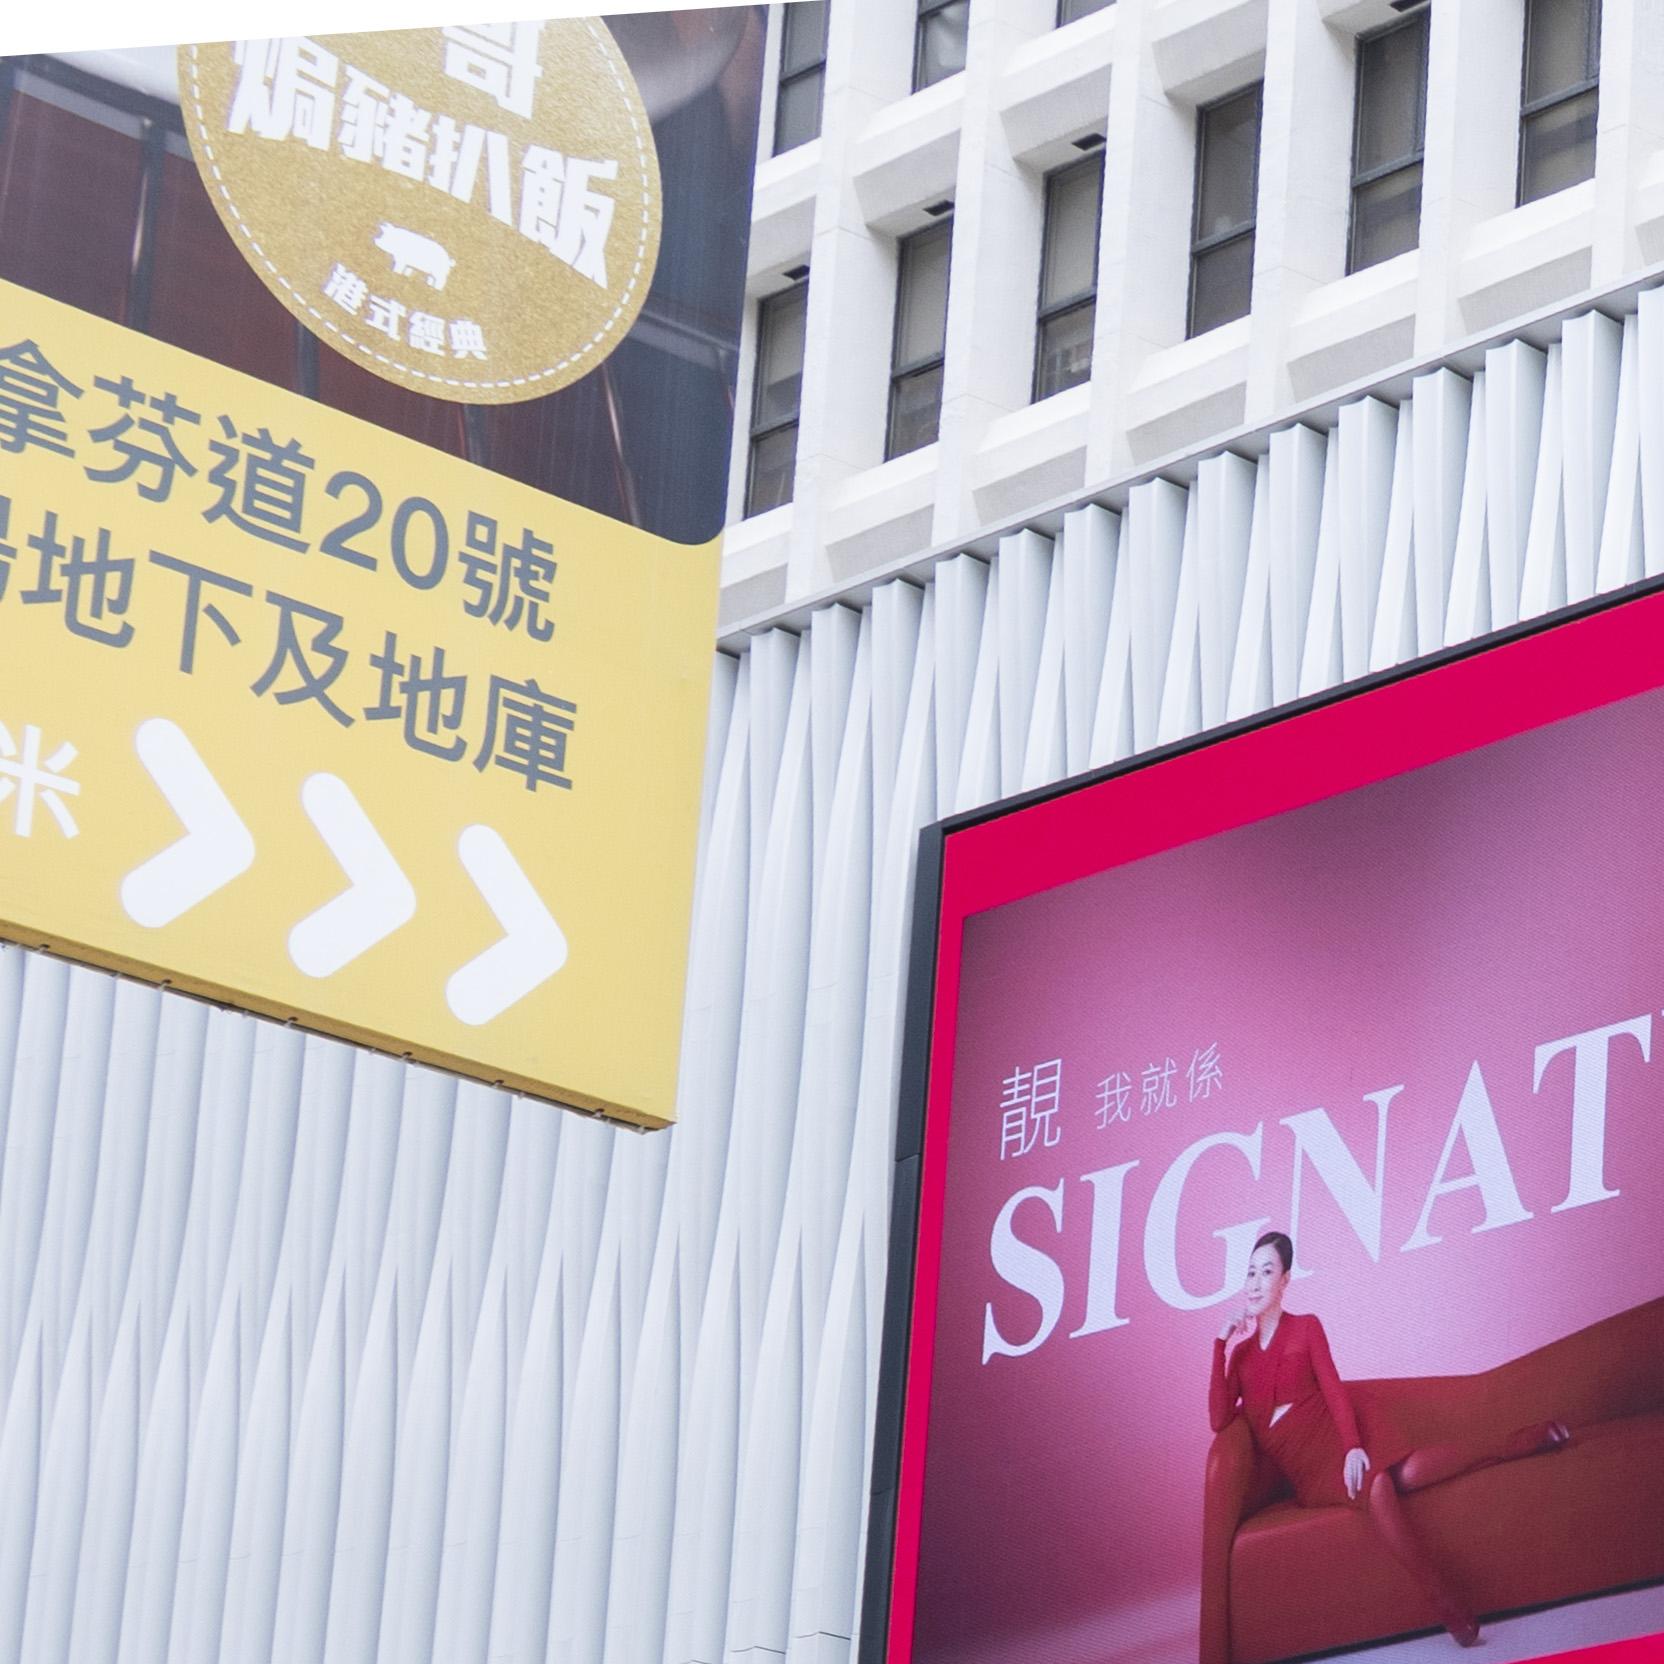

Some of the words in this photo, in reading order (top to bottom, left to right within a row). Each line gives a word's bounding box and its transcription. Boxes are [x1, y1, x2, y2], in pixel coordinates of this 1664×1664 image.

[225, 36, 618, 289] 焗豬扒飯
[322, 262, 488, 360] 港式經典
[0, 338, 558, 643] 拿芬道20號
[998, 1057, 1063, 1160] 靚
[1094, 1042, 1225, 1130] 我就係
